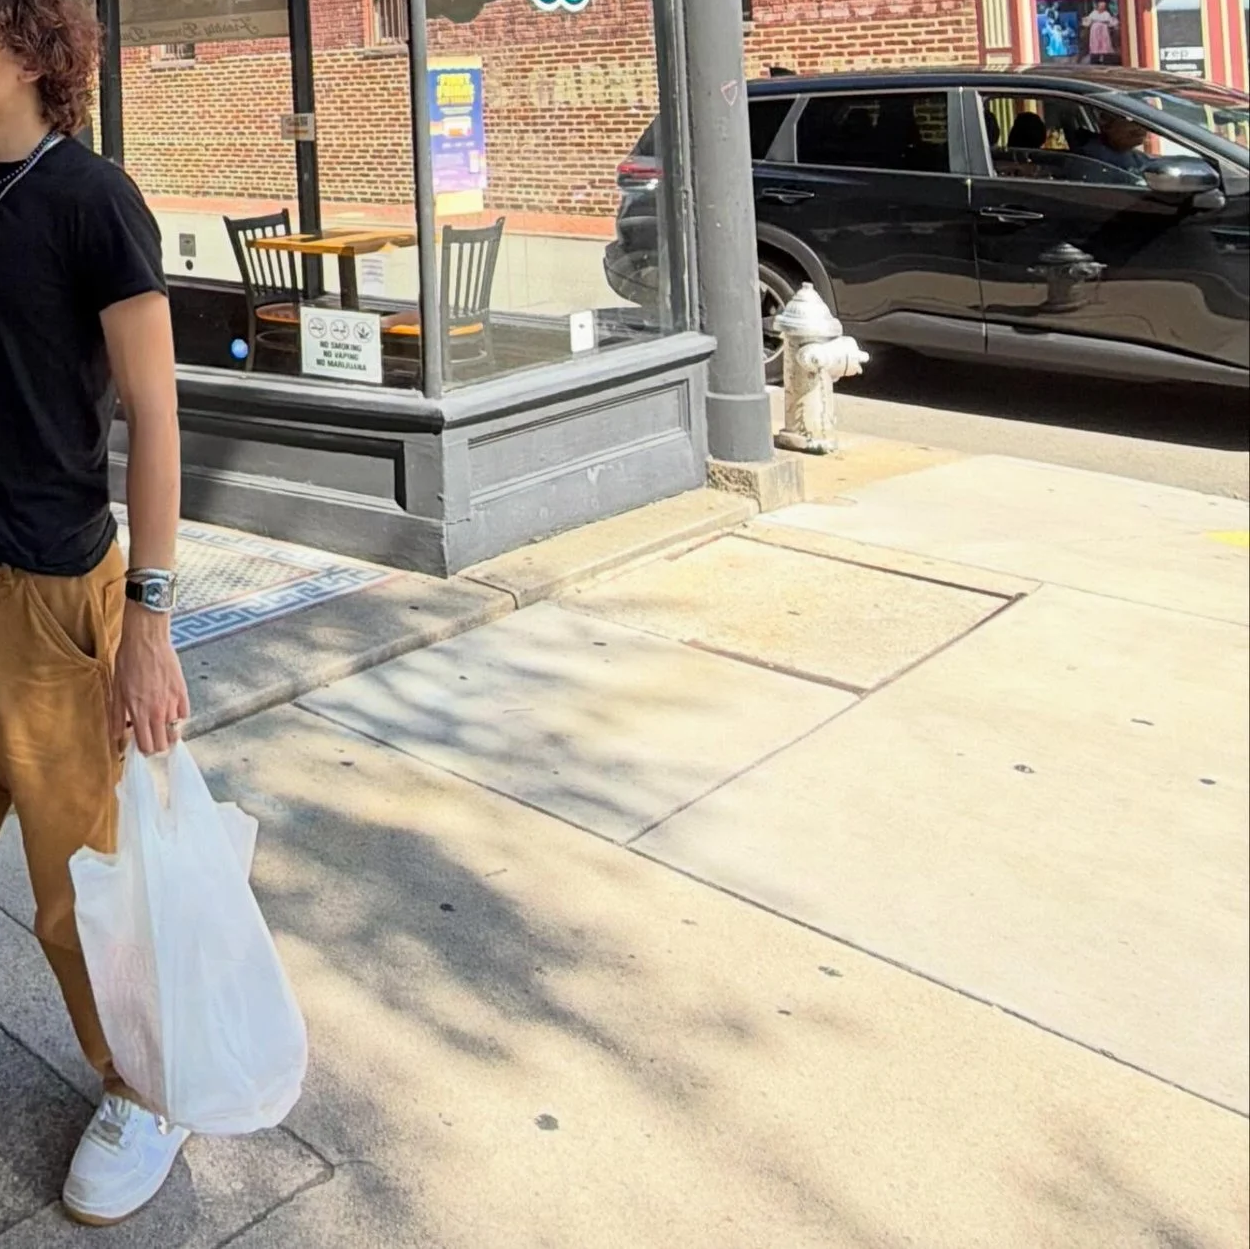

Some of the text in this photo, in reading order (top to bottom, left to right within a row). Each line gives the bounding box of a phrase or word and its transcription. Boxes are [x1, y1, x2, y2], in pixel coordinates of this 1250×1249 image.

[319, 341, 362, 352] NO SMOKING
[323, 350, 359, 361] NO VAPING
[316, 358, 367, 371] NO MARIJUANA
